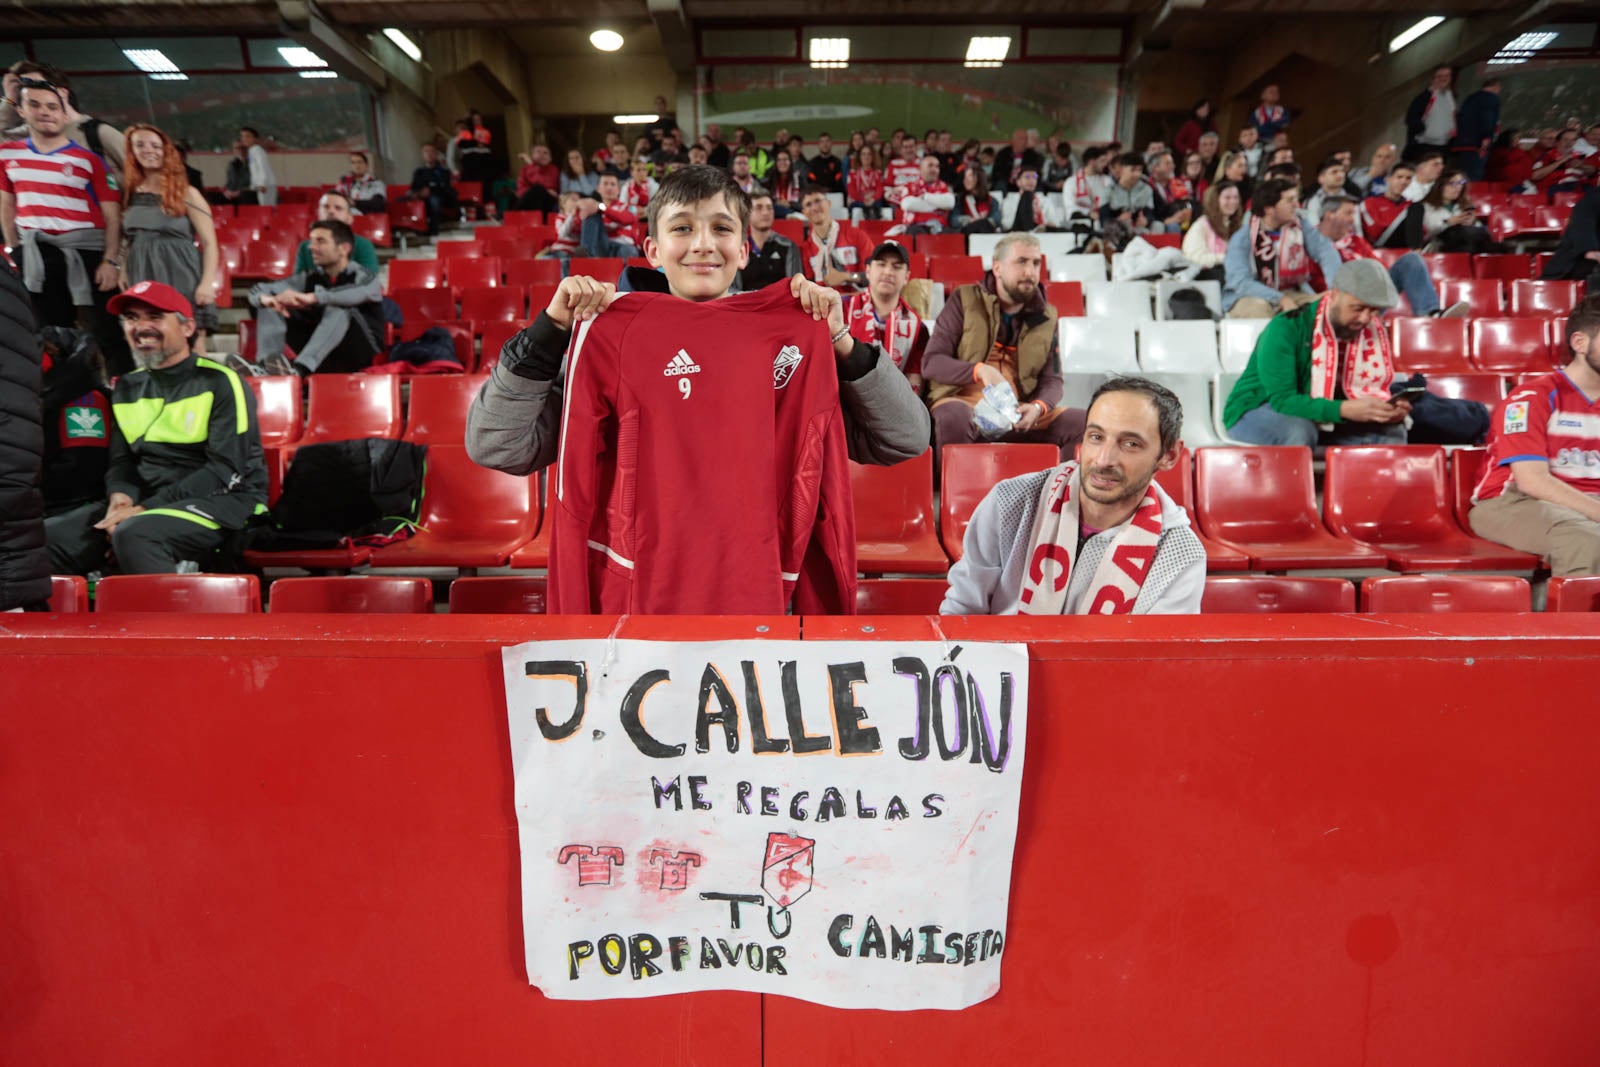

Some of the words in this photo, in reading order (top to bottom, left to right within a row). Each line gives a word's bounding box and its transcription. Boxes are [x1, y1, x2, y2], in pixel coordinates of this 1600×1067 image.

[663, 365, 701, 377] adidas
[678, 377, 692, 400] 9
[526, 660, 605, 742] J.
[620, 645, 1015, 773] CALLEJÓN
[652, 775, 713, 810] ME
[736, 780, 945, 821] REGALAS
[827, 914, 1003, 965] CAMISETA
